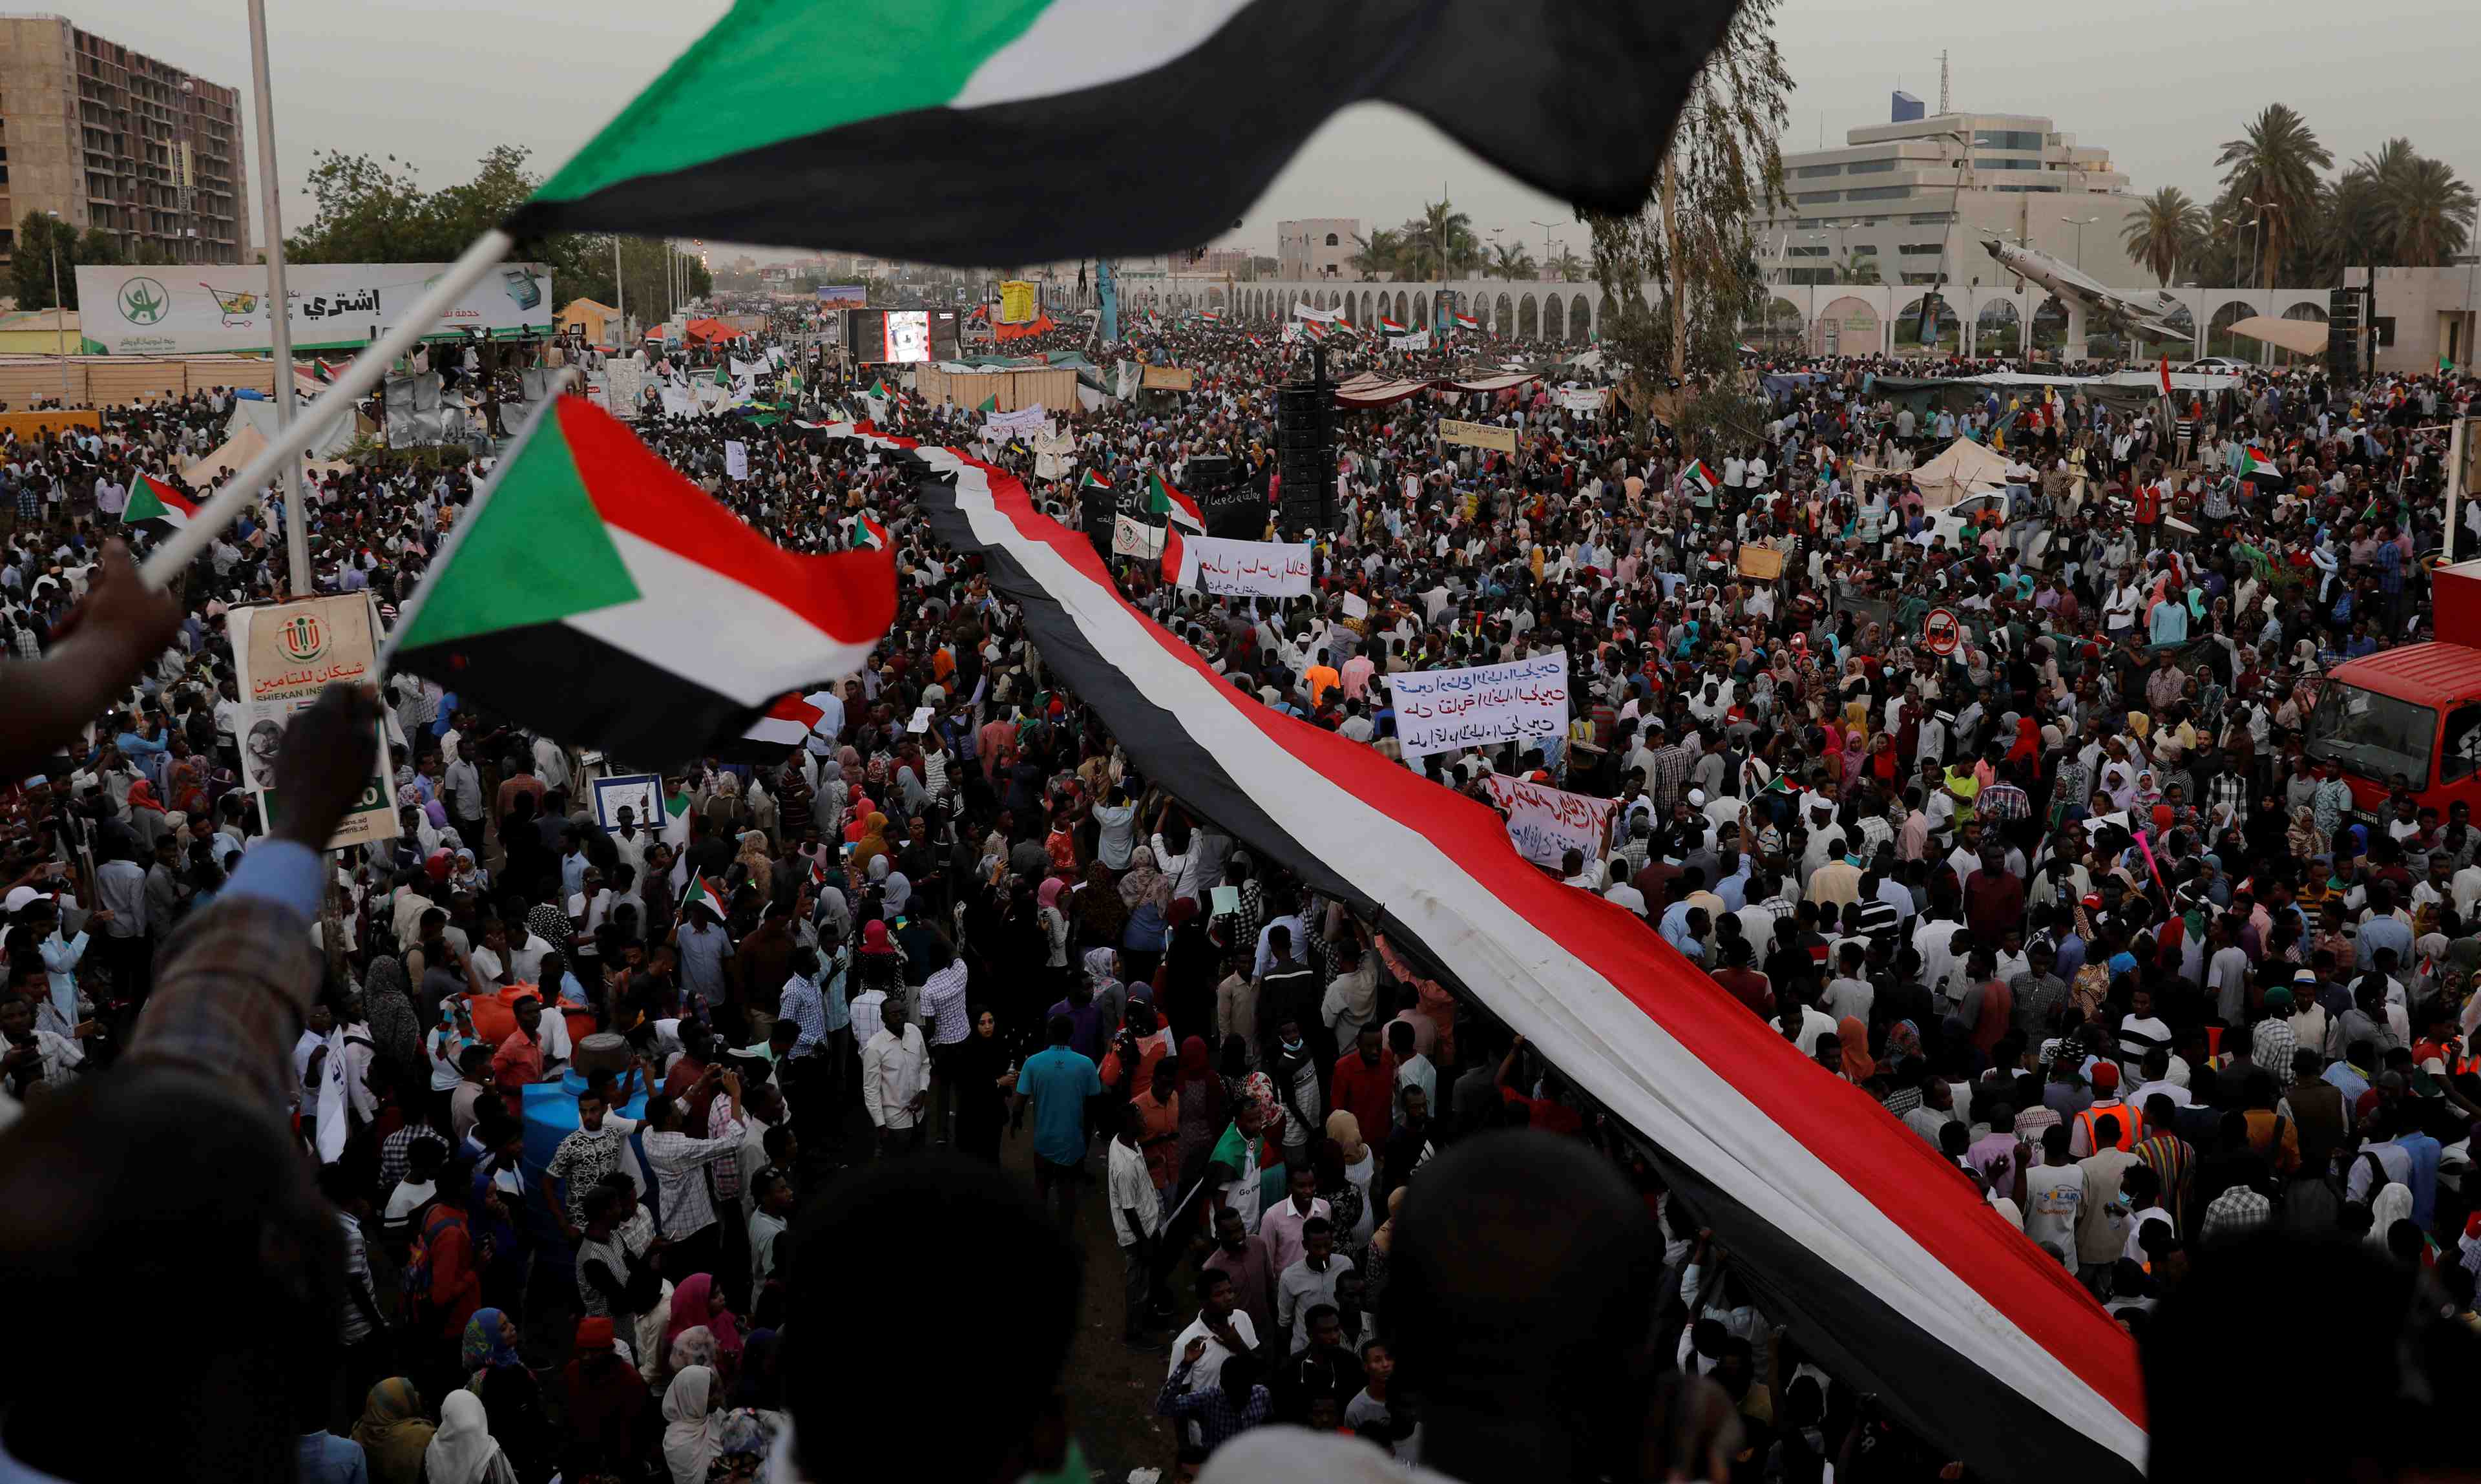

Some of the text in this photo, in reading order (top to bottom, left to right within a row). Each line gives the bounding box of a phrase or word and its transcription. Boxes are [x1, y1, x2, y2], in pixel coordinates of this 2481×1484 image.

[304, 289, 381, 320] إشتري
[317, 661, 365, 684] شيكان
[256, 689, 303, 702] SHIEKAN
